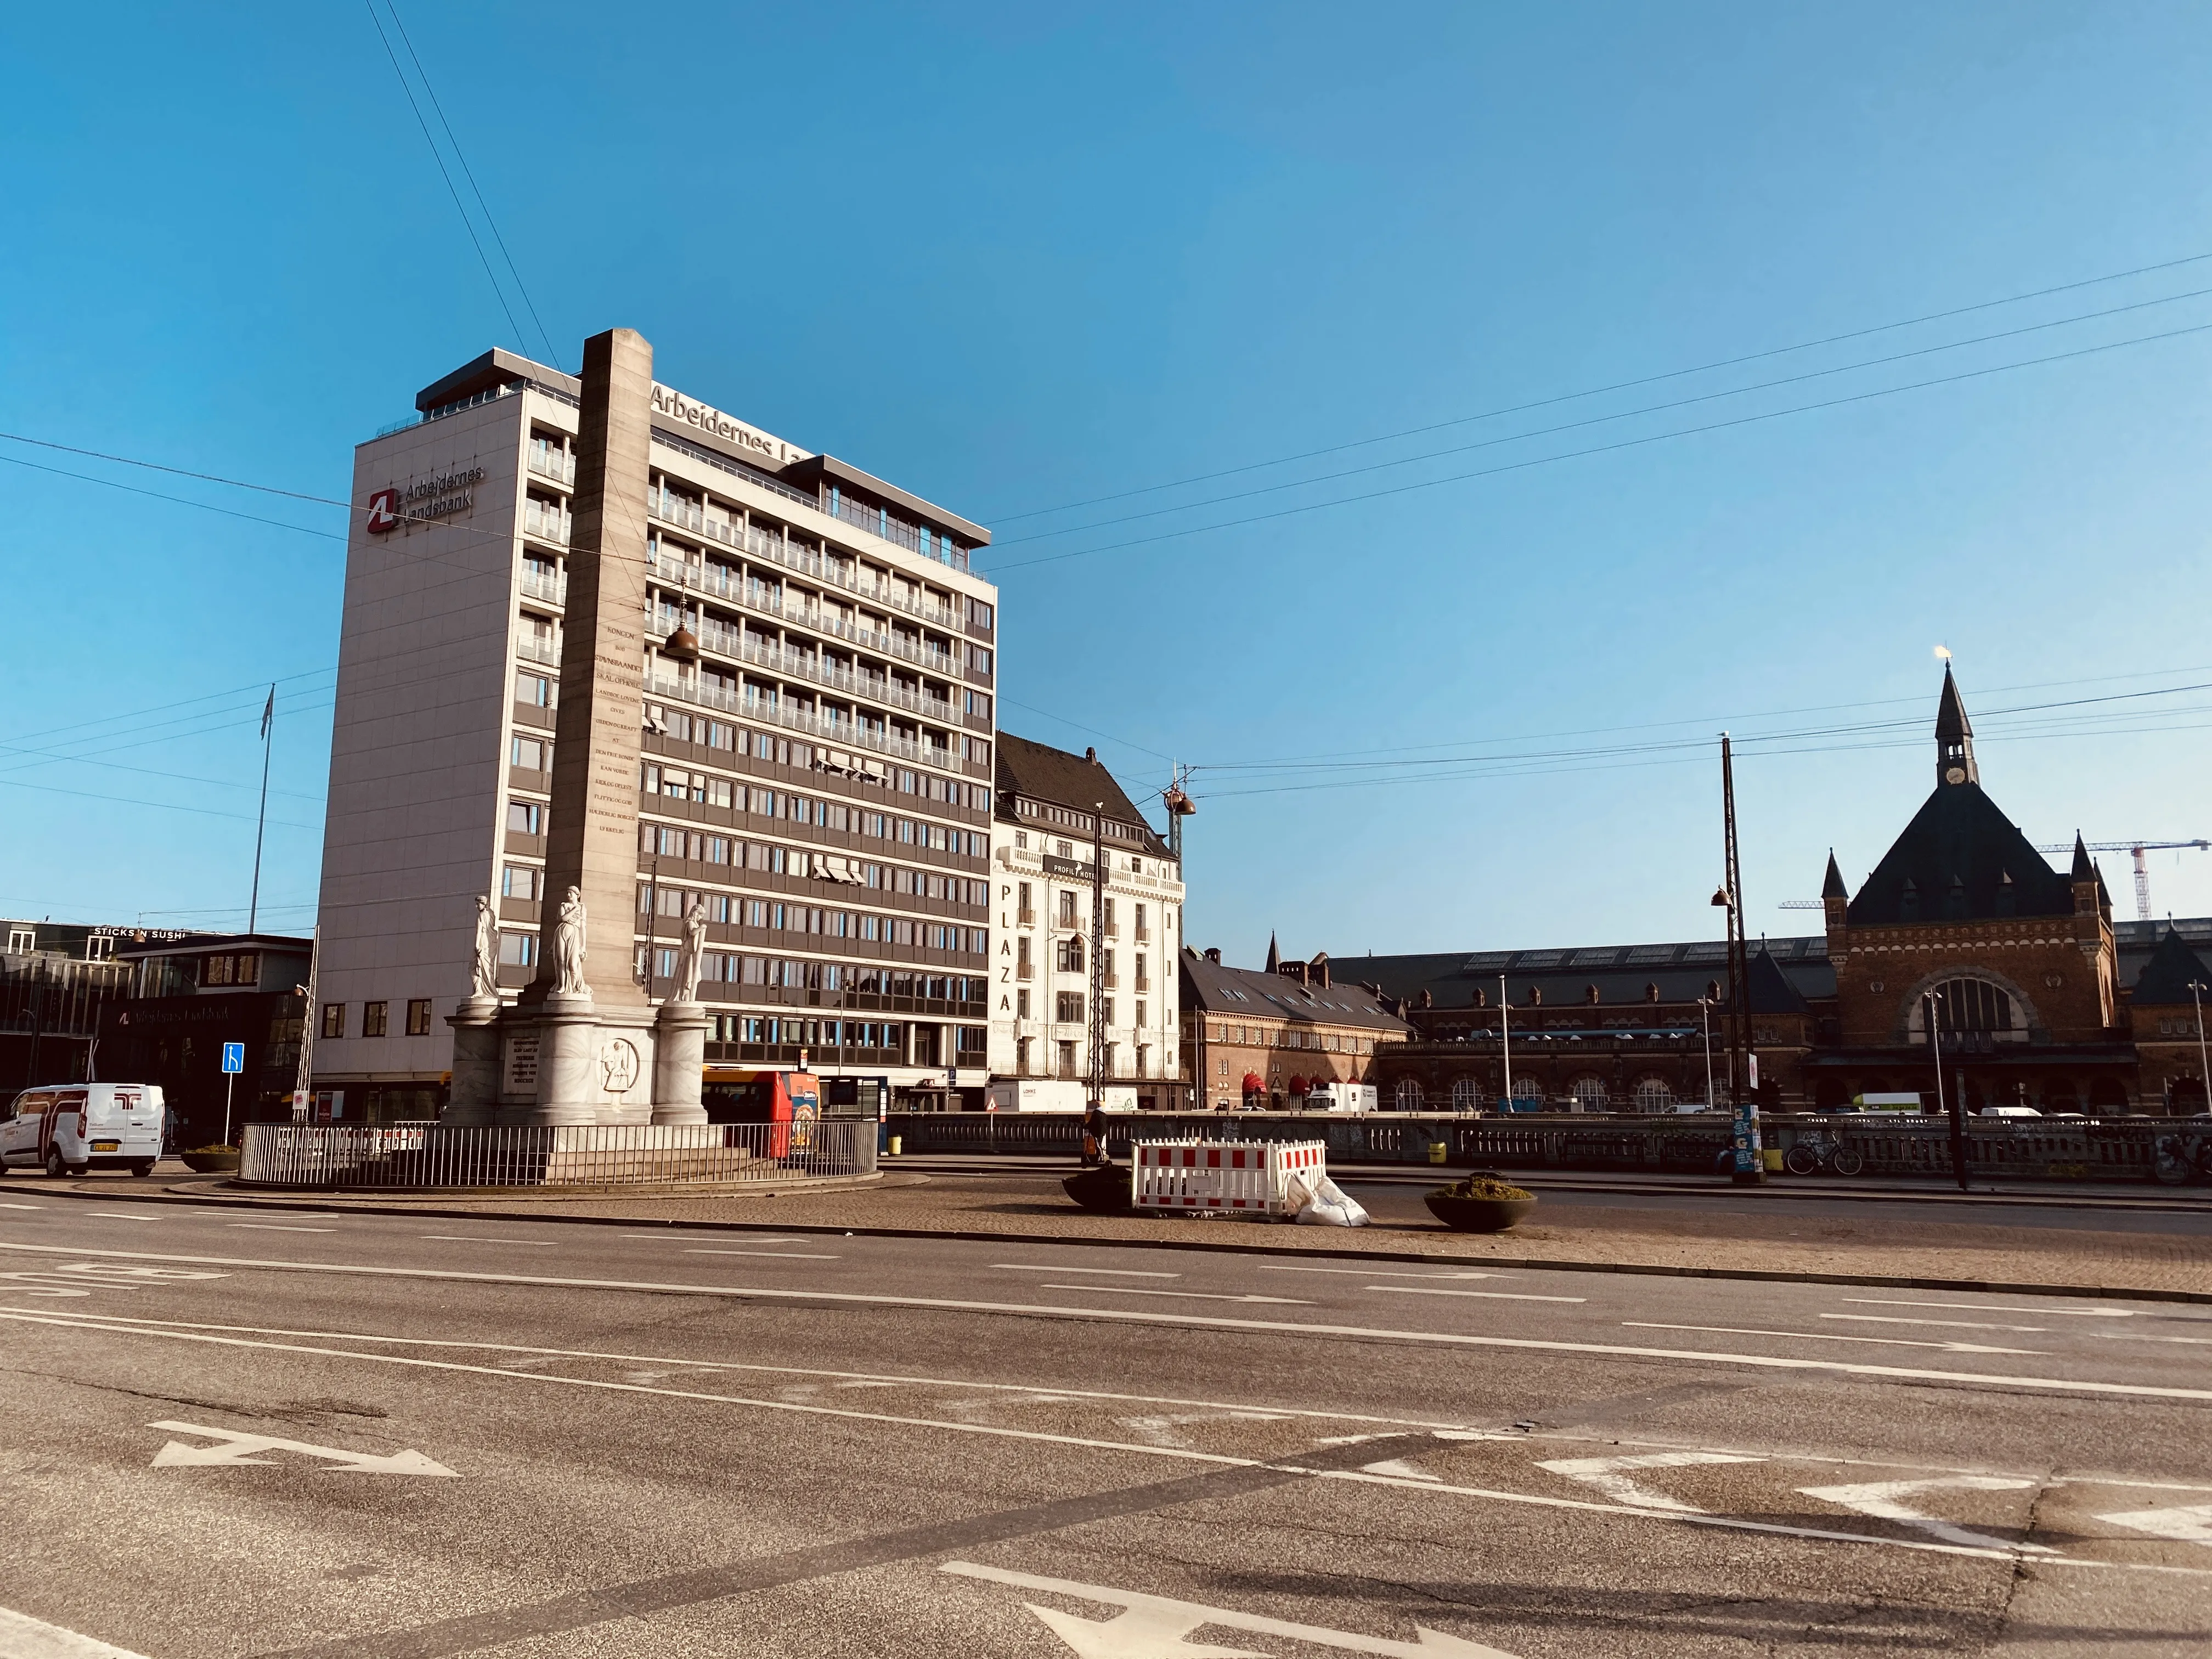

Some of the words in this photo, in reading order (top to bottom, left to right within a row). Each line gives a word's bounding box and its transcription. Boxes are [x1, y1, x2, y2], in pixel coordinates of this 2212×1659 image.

[405, 466, 485, 503] Arbejdernes
[403, 488, 473, 524] Landsbank
[607, 626, 634, 640] KONGEN
[596, 672, 614, 682] SKAL
[596, 719, 613, 727] ORDEN
[620, 724, 637, 732] KRAFT
[618, 754, 635, 762] BONDE
[594, 794, 614, 803] FLITTIG
[1054, 865, 1075, 876] PROFIL
[94, 927, 135, 937] STICKS
[1000, 884, 1011, 1011] PLAZA
